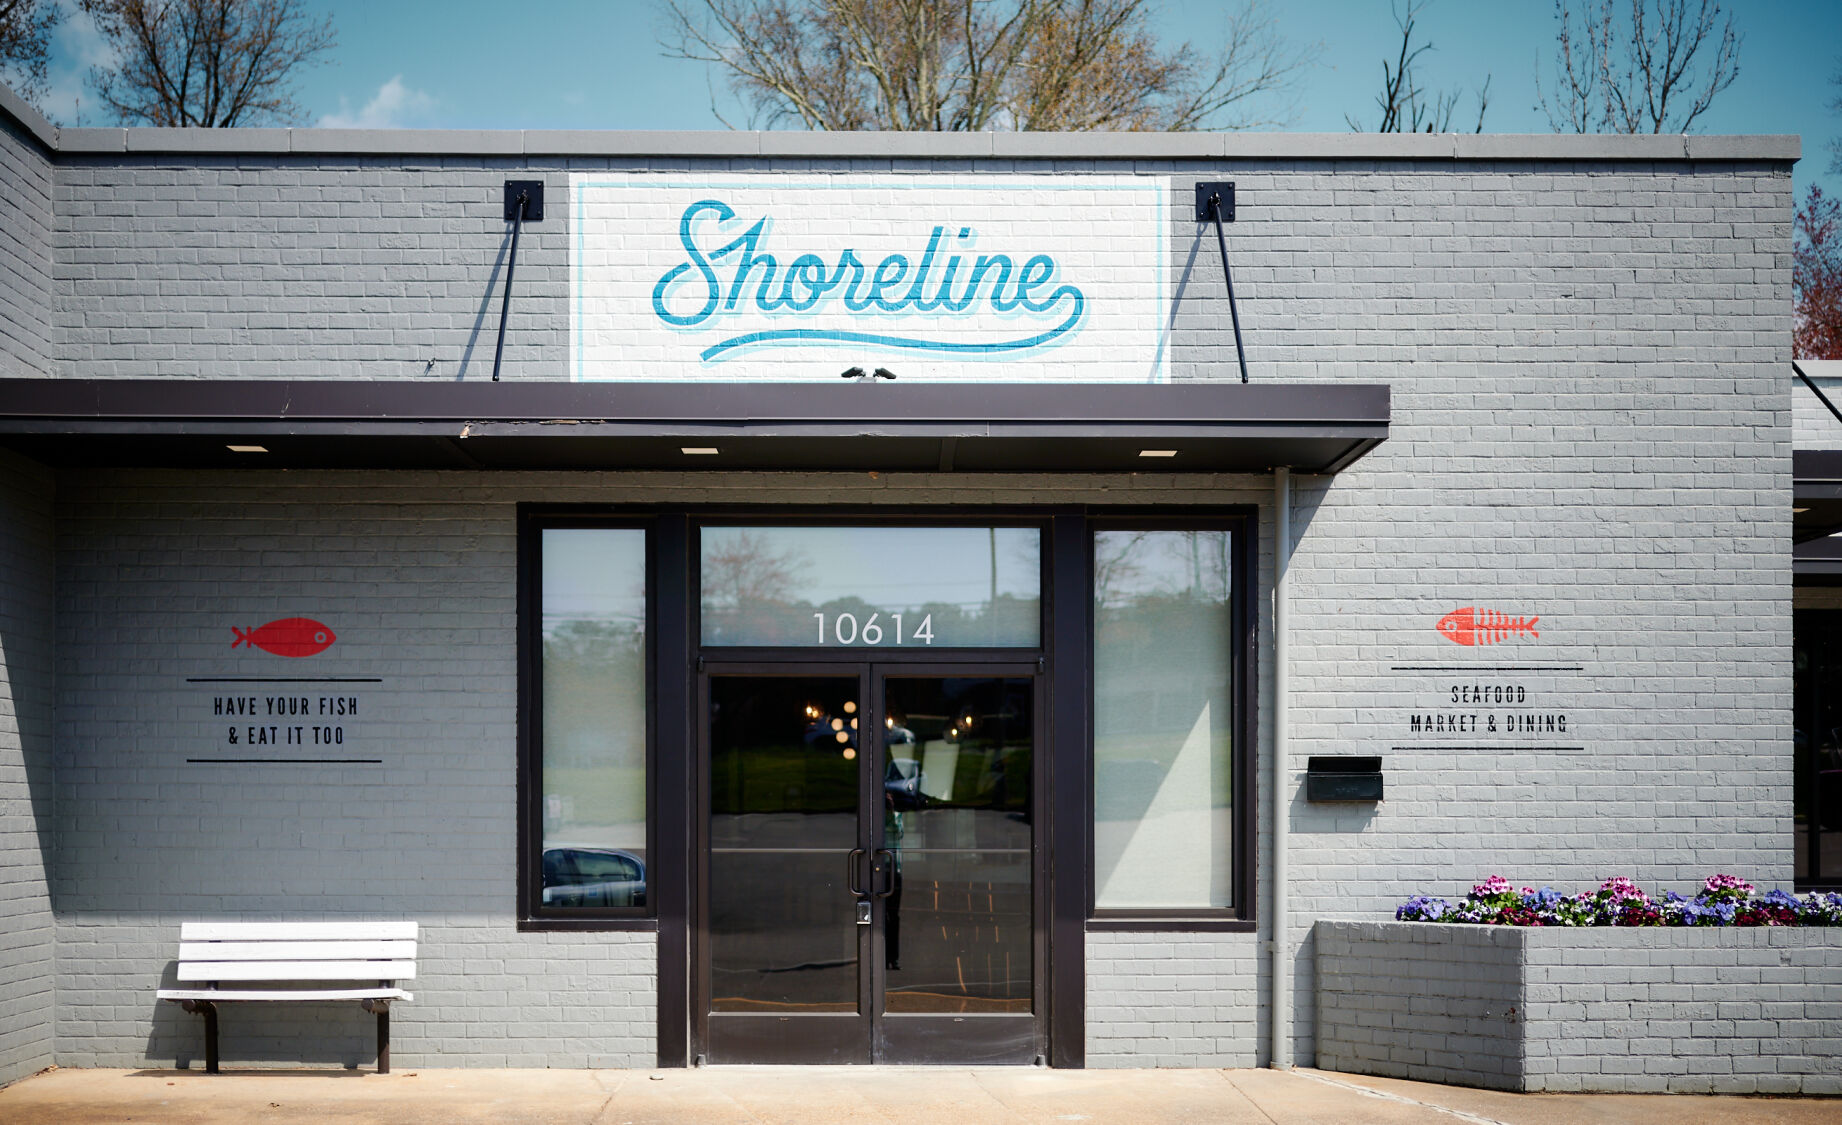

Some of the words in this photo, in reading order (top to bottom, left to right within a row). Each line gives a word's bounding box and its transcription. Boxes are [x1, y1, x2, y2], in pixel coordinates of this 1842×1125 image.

[652, 199, 1090, 365] Shoreline
[813, 612, 935, 645] 10614
[1451, 685, 1526, 704] SEAFOOD
[214, 697, 257, 716] HAVE
[266, 697, 309, 716] YOUR
[319, 697, 358, 716] FISH
[1410, 714, 1478, 733] MARKET
[1487, 714, 1497, 733] &
[1507, 714, 1567, 733] DINING
[228, 726, 239, 745] &
[248, 726, 278, 745] EAT
[287, 726, 304, 745] IT
[313, 726, 344, 745] TOO
